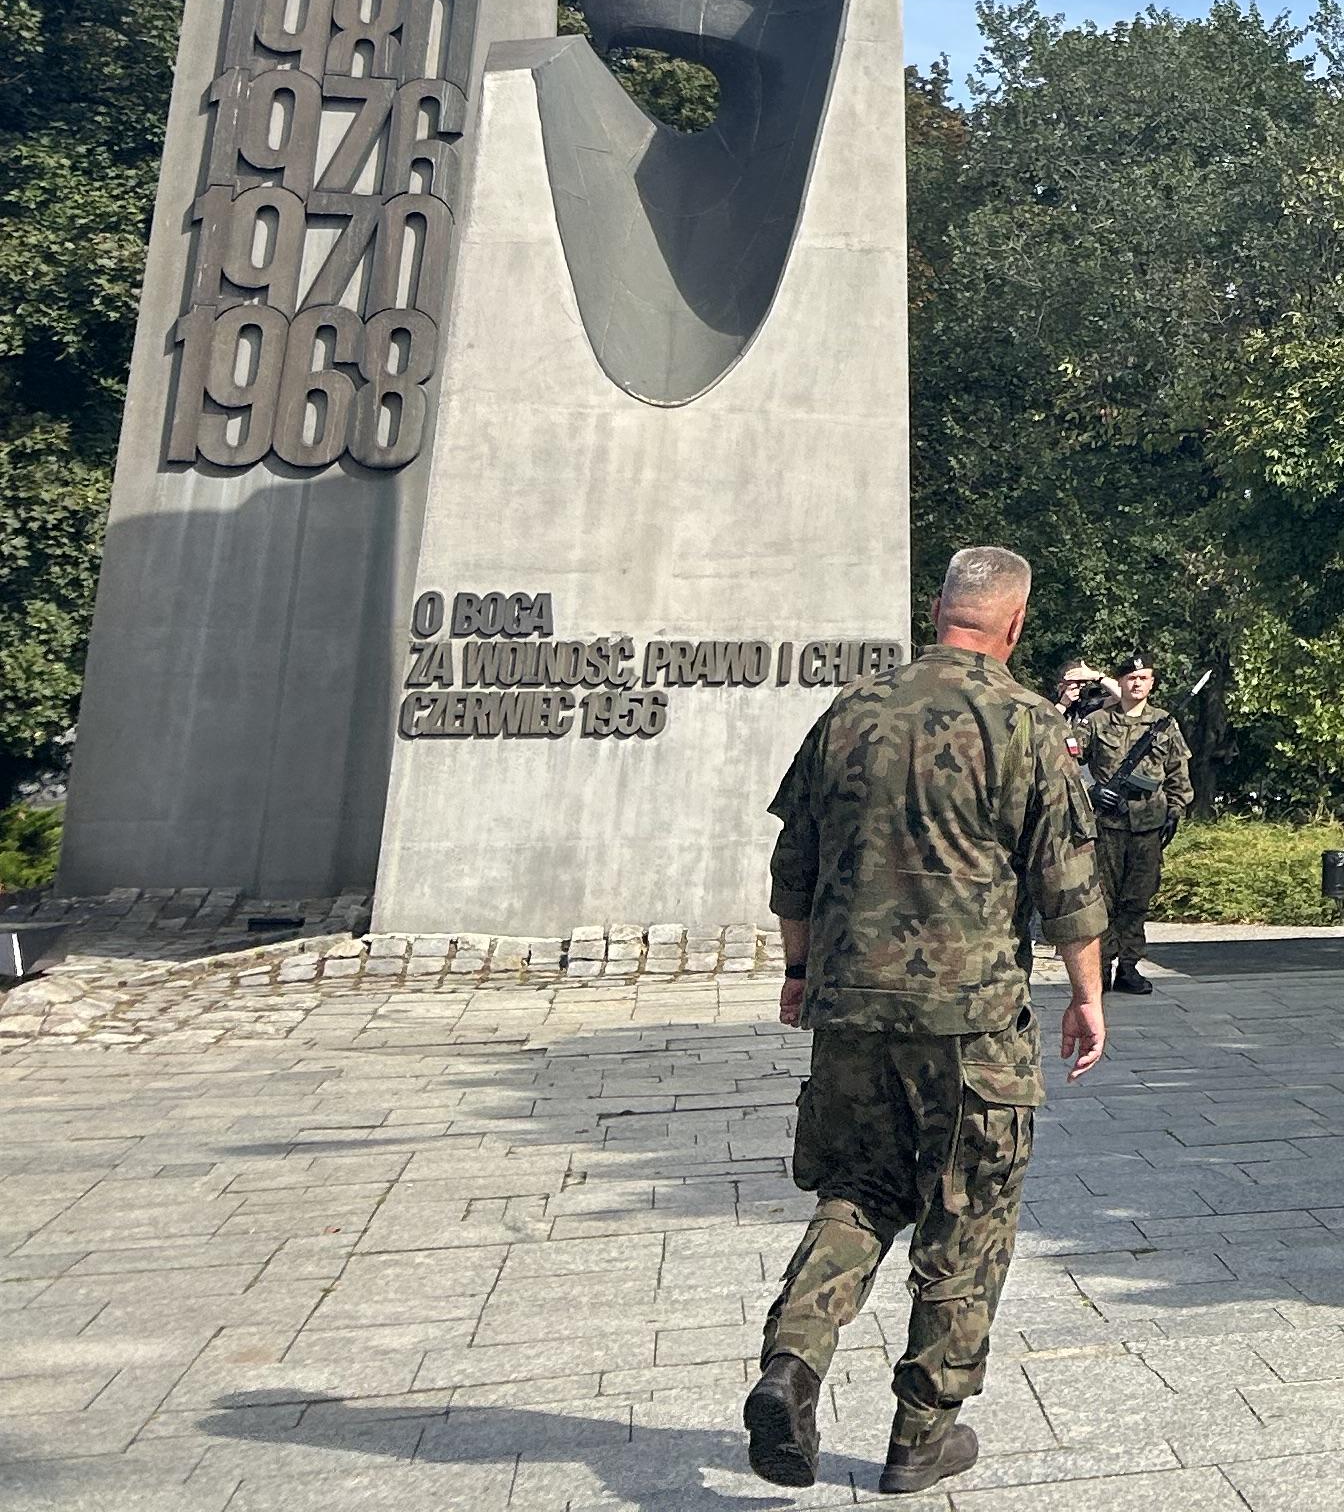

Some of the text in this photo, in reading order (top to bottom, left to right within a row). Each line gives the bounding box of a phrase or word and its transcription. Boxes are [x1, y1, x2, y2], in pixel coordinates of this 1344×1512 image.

[207, 67, 468, 200] 1976
[191, 185, 456, 310] 1970
[166, 303, 439, 470] 1968
[411, 591, 554, 638] O BOGA
[404, 641, 454, 688] ZA
[641, 640, 772, 688] PRAWO
[776, 642, 794, 688] I
[398, 690, 668, 739] CZERWIEC 1956
